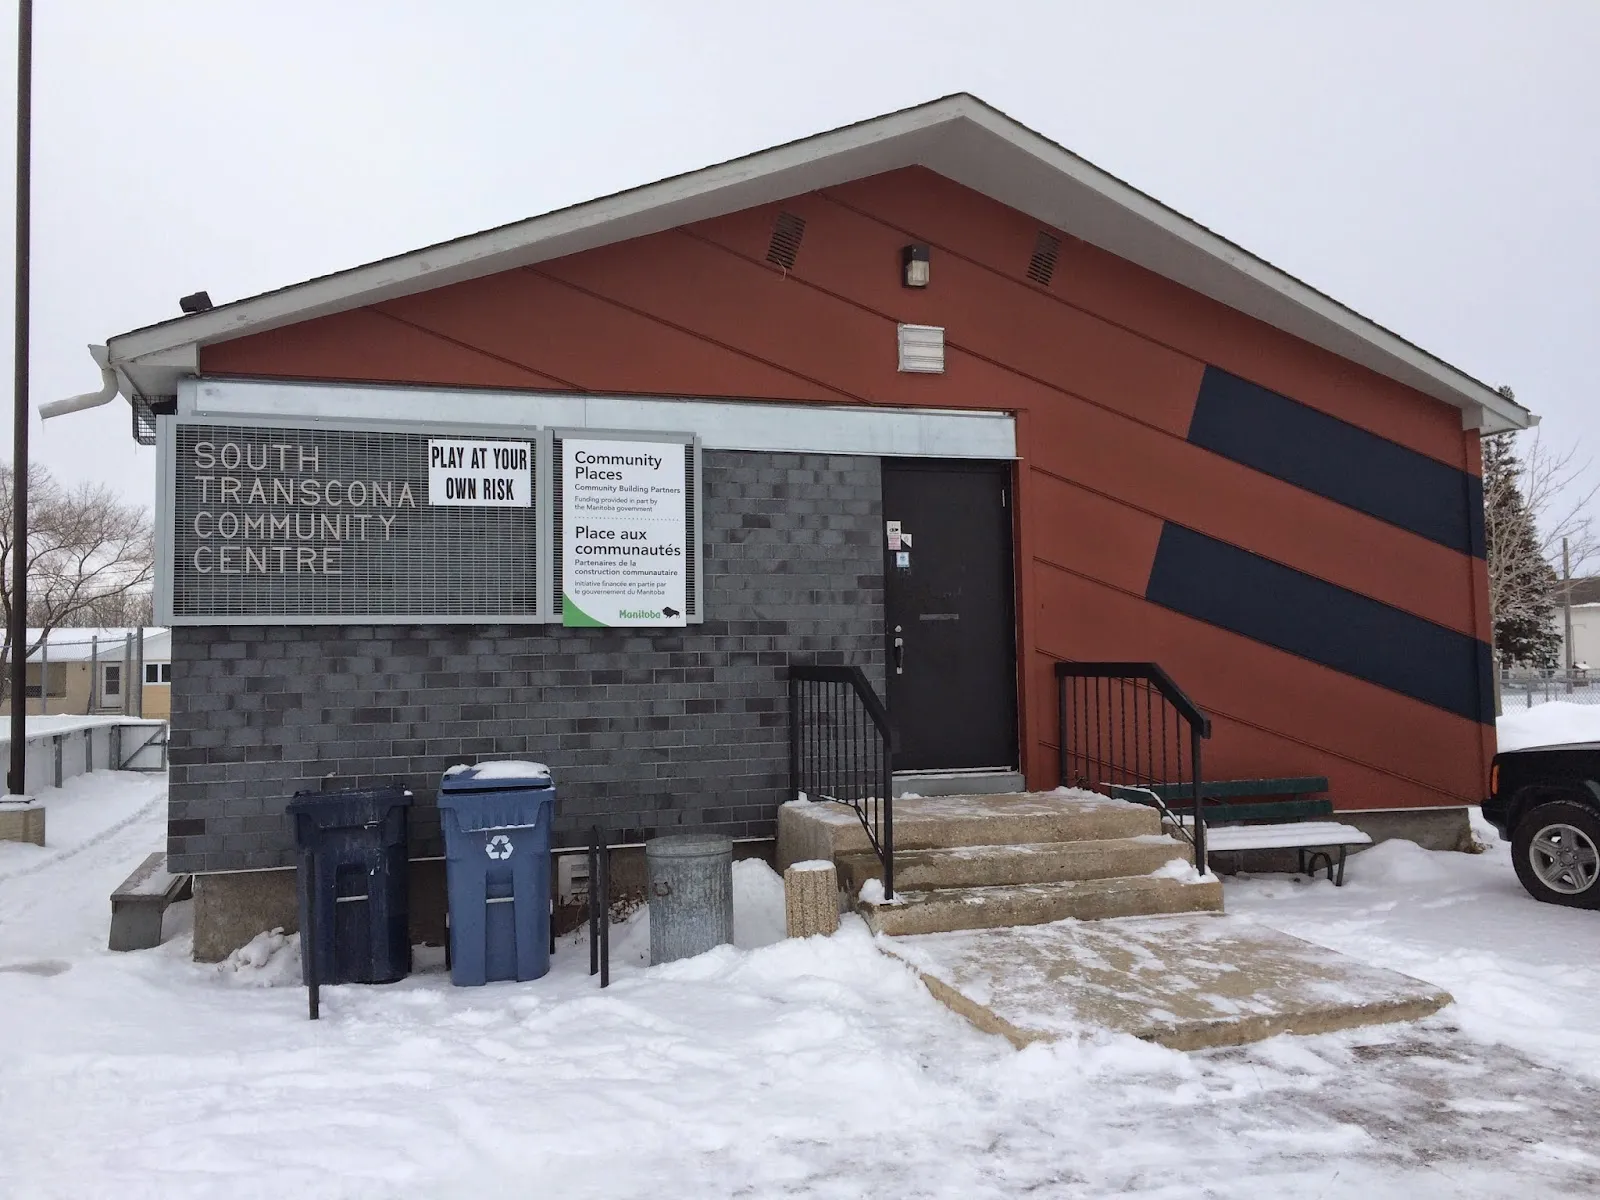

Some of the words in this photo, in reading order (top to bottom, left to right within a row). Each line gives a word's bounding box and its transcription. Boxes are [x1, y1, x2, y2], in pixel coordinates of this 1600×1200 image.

[194, 442, 320, 472] SOUTH
[431, 445, 464, 469] PLAY
[471, 449, 488, 470] AT
[493, 448, 528, 470] YOUR
[575, 450, 662, 470] Community
[575, 466, 623, 480] Places
[194, 475, 416, 508] TRANSCONA
[445, 477, 477, 500] OWN
[483, 479, 515, 501] RISK
[574, 484, 618, 493] Community
[619, 485, 649, 494] Building
[574, 496, 600, 504] Funding
[194, 511, 397, 541] COMMUNITY
[575, 526, 616, 540] Place
[620, 530, 647, 540] aux
[194, 546, 343, 574] CENTRE
[575, 544, 681, 556] communautés
[619, 610, 661, 619] Manitoba
